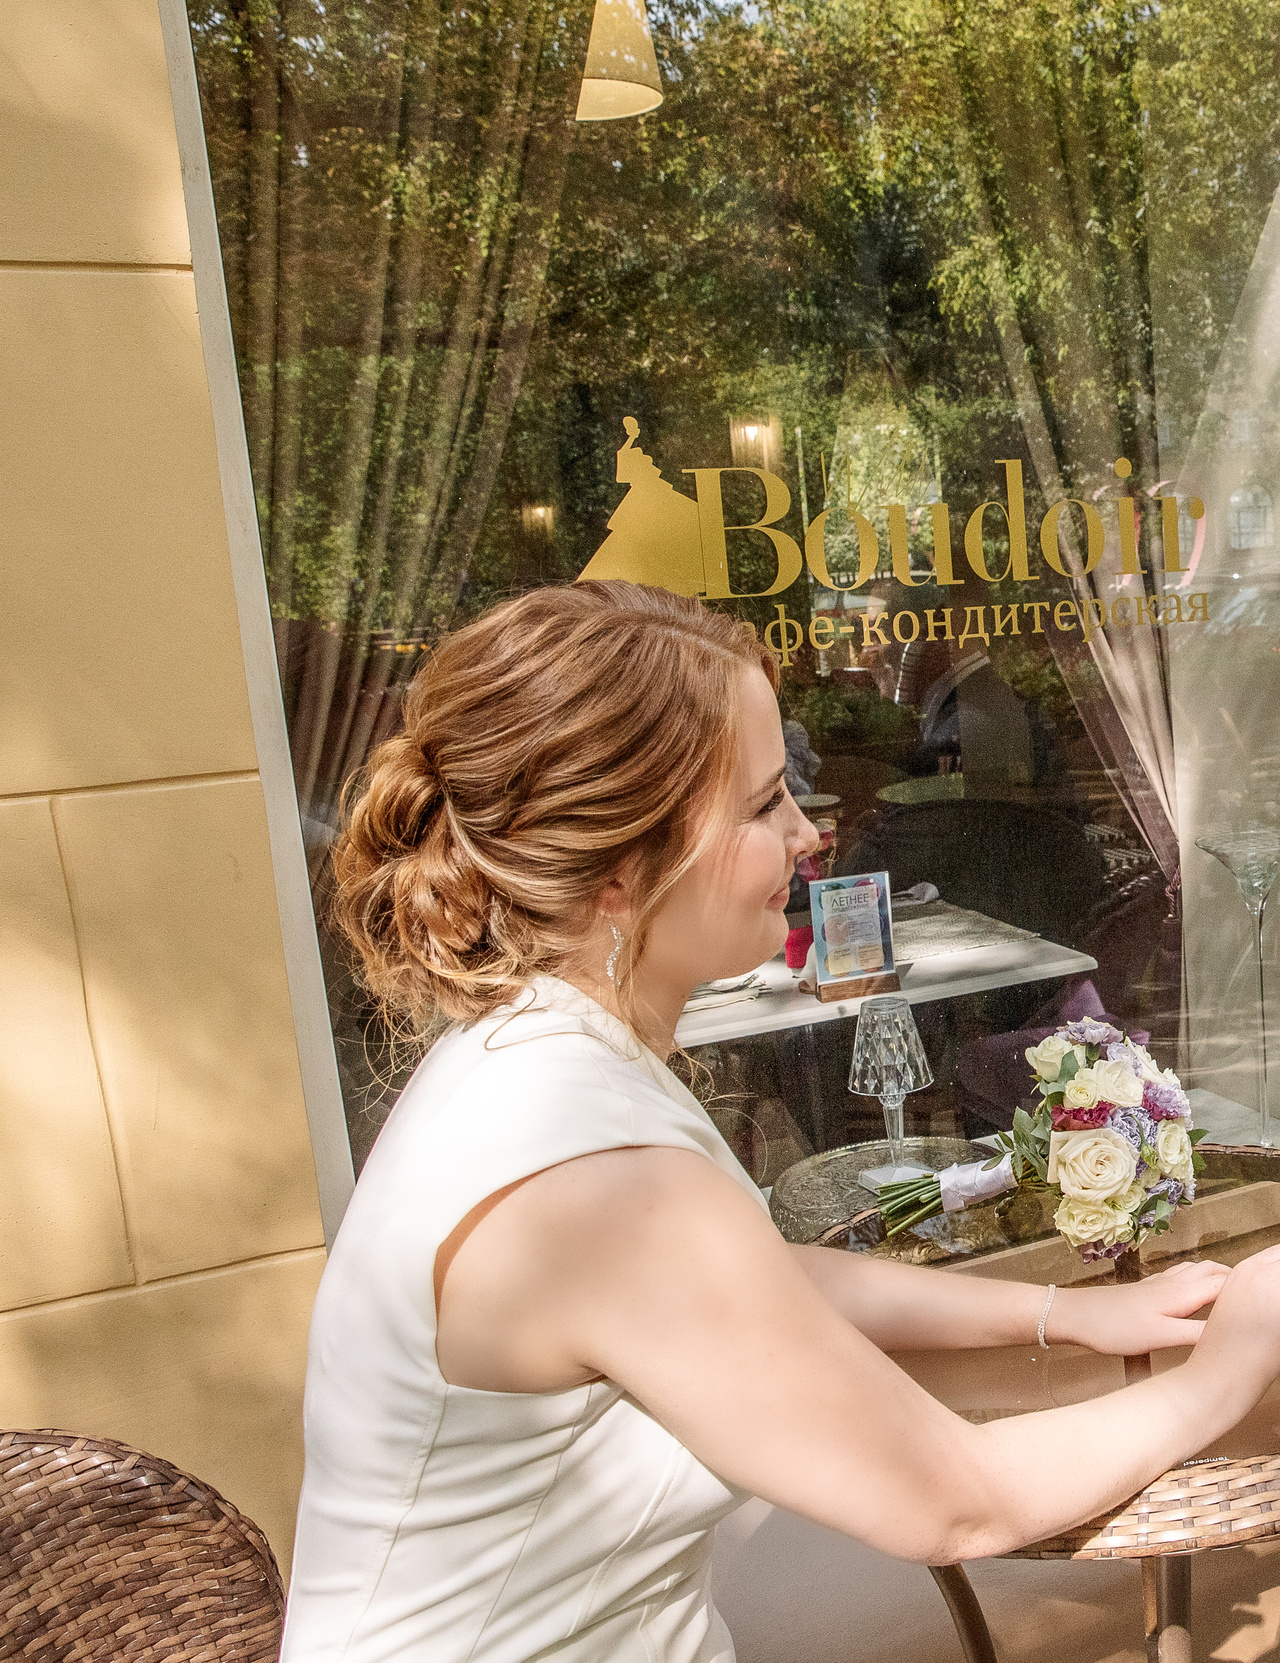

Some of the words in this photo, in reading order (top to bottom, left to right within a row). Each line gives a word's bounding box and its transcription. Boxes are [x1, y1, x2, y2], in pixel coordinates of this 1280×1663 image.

[681, 457, 1206, 601] Boudoir
[738, 592, 1212, 668] фе-кондитерская
[831, 892, 869, 908] ЛЕТНЕЕ
[1183, 1456, 1230, 1467] Tempered
